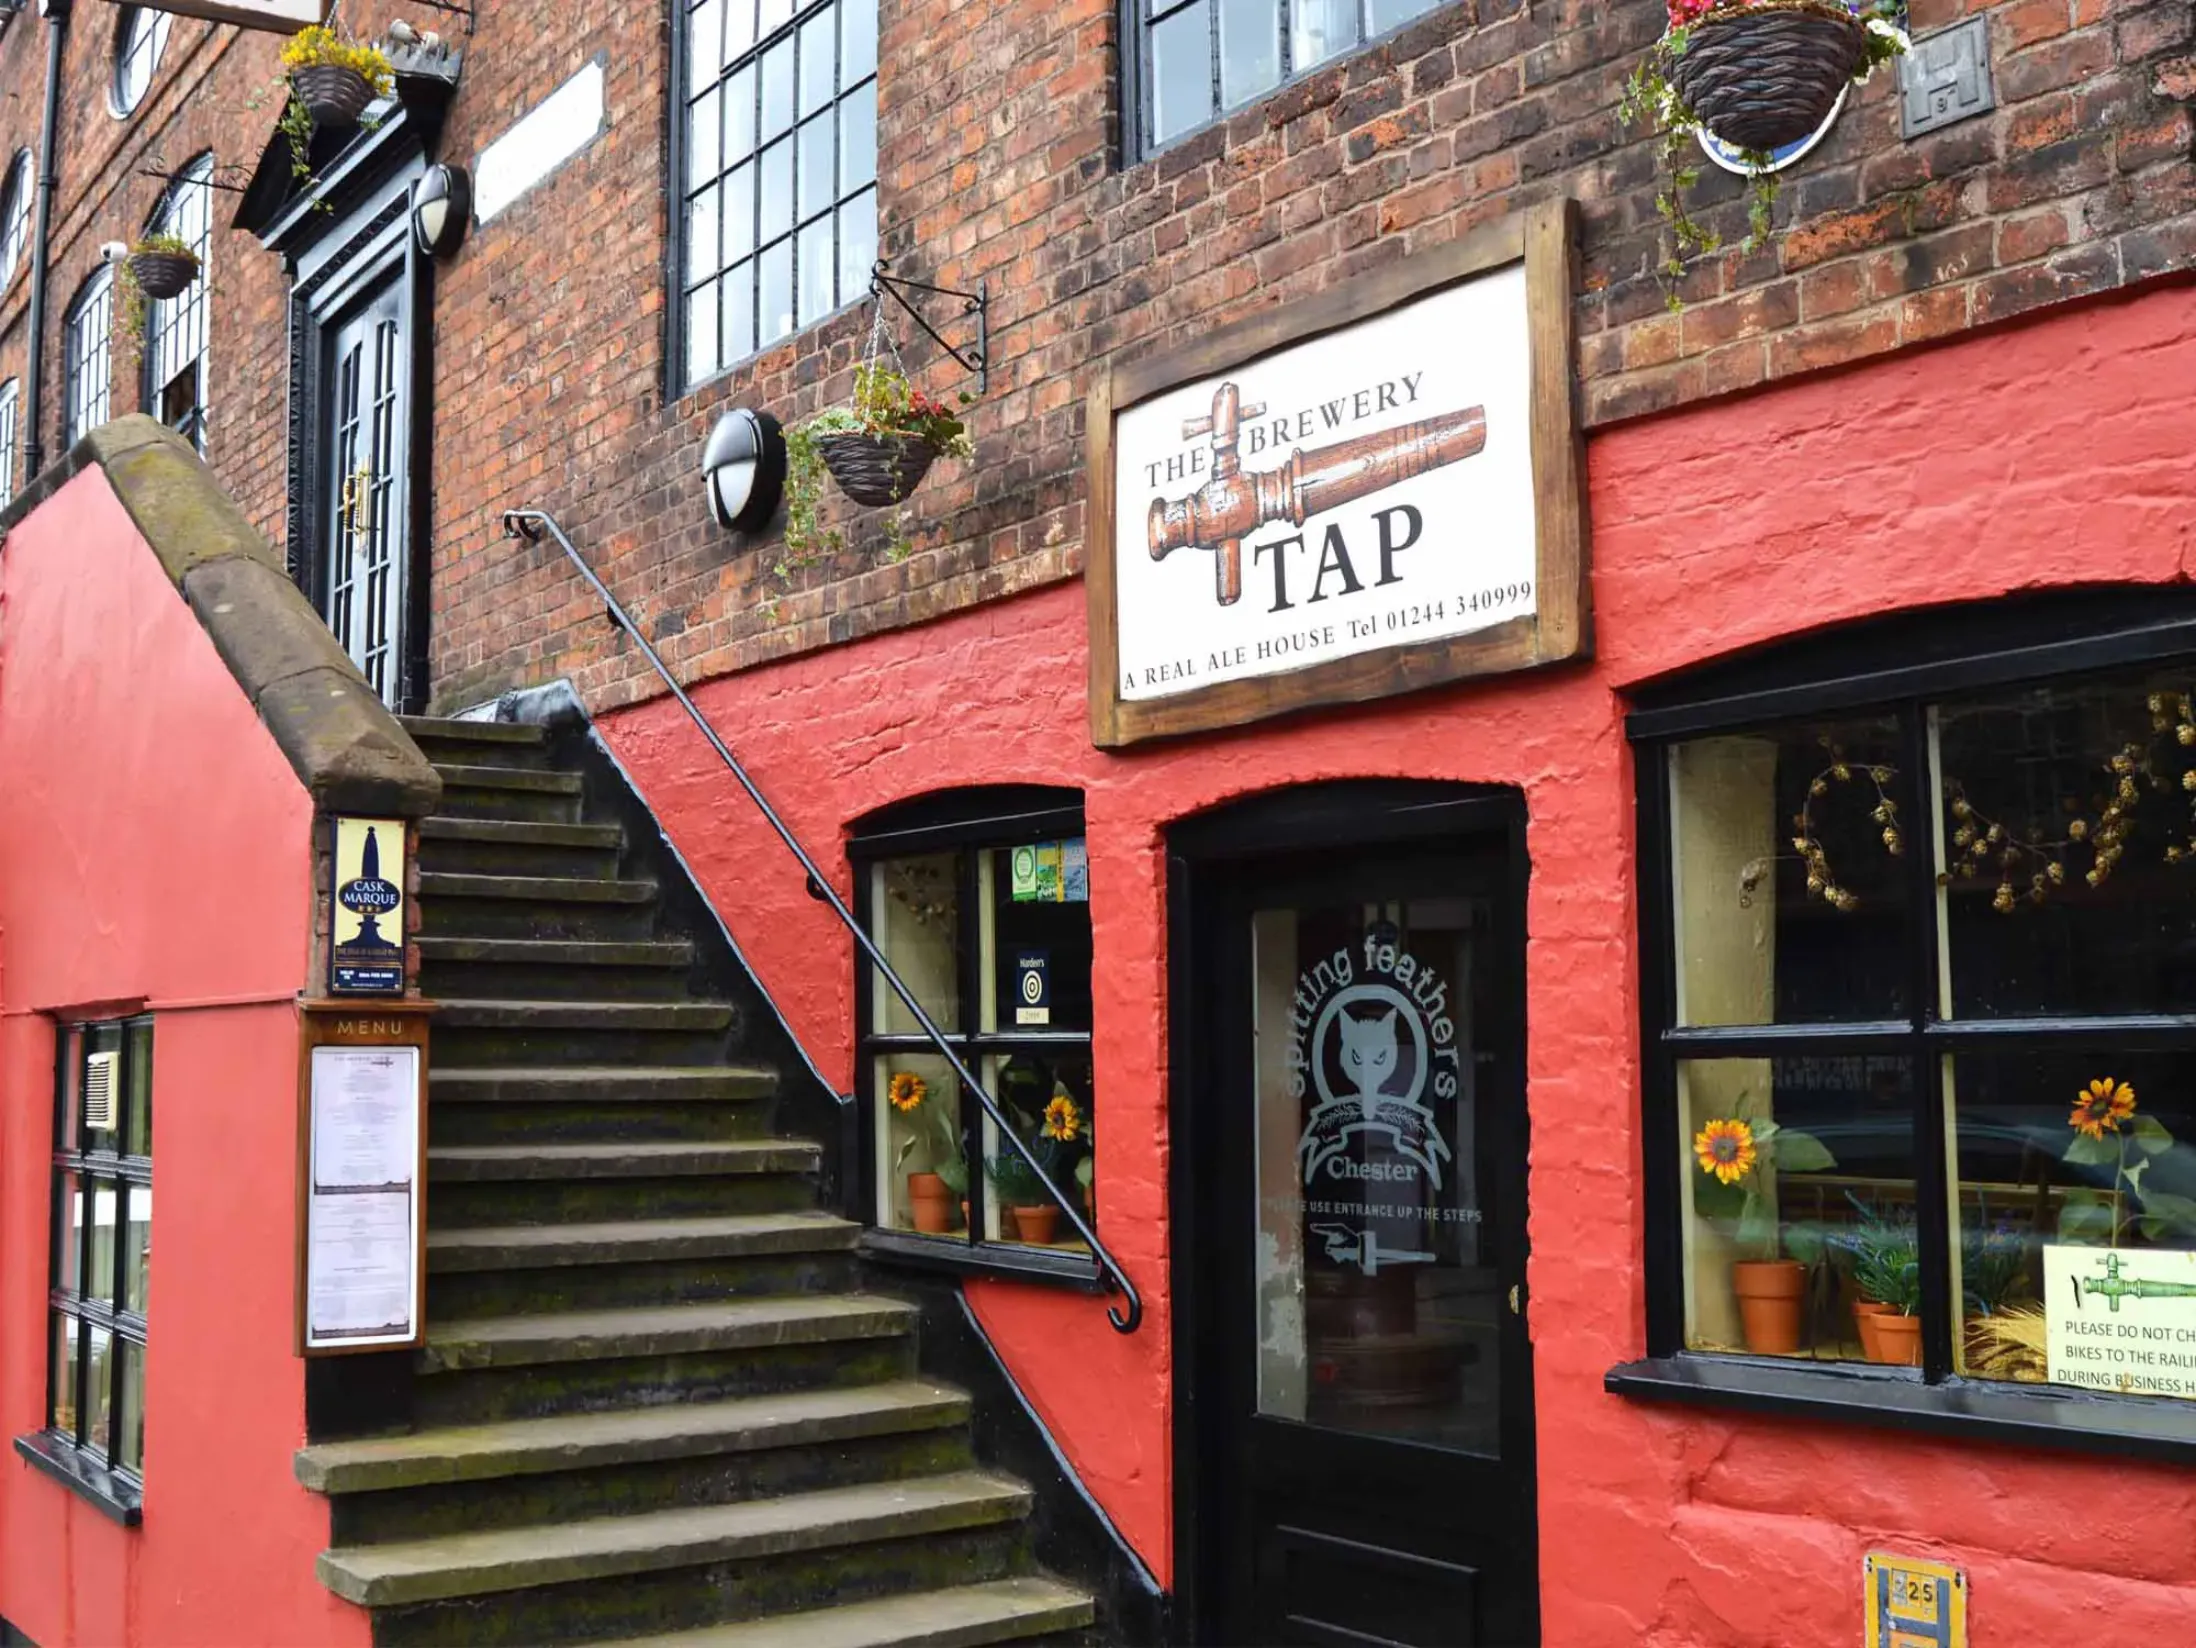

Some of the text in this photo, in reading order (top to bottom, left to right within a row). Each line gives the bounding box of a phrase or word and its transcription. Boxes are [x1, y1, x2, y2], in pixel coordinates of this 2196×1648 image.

[1144, 370, 1425, 489] THE BREWERY
[1253, 503, 1423, 614] TAP
[1124, 580, 1532, 690] A REAL ALE HOUSE Tel 01244 340999
[353, 880, 385, 892] CASK
[344, 892, 397, 905] MARQUE
[336, 1020, 402, 1035] MENU
[1364, 934, 1460, 1100] feathers
[1326, 1156, 1419, 1182] Chester
[1310, 1201, 1331, 1213] USE
[1334, 1203, 1394, 1218] ENTRANCE
[1397, 1206, 1413, 1219] UP
[1417, 1207, 1439, 1221] THE
[1443, 1209, 1483, 1223] STEPS
[2065, 1321, 2113, 1337] PLEASE
[2117, 1325, 2138, 1338] DO
[2142, 1327, 2172, 1340] NOT
[2065, 1345, 2102, 1361] BIKES
[2106, 1348, 2125, 1362] TO
[2129, 1350, 2156, 1365] THE
[2057, 1369, 2111, 1386] DURING
[2115, 1373, 2181, 1392] BUSINESS
